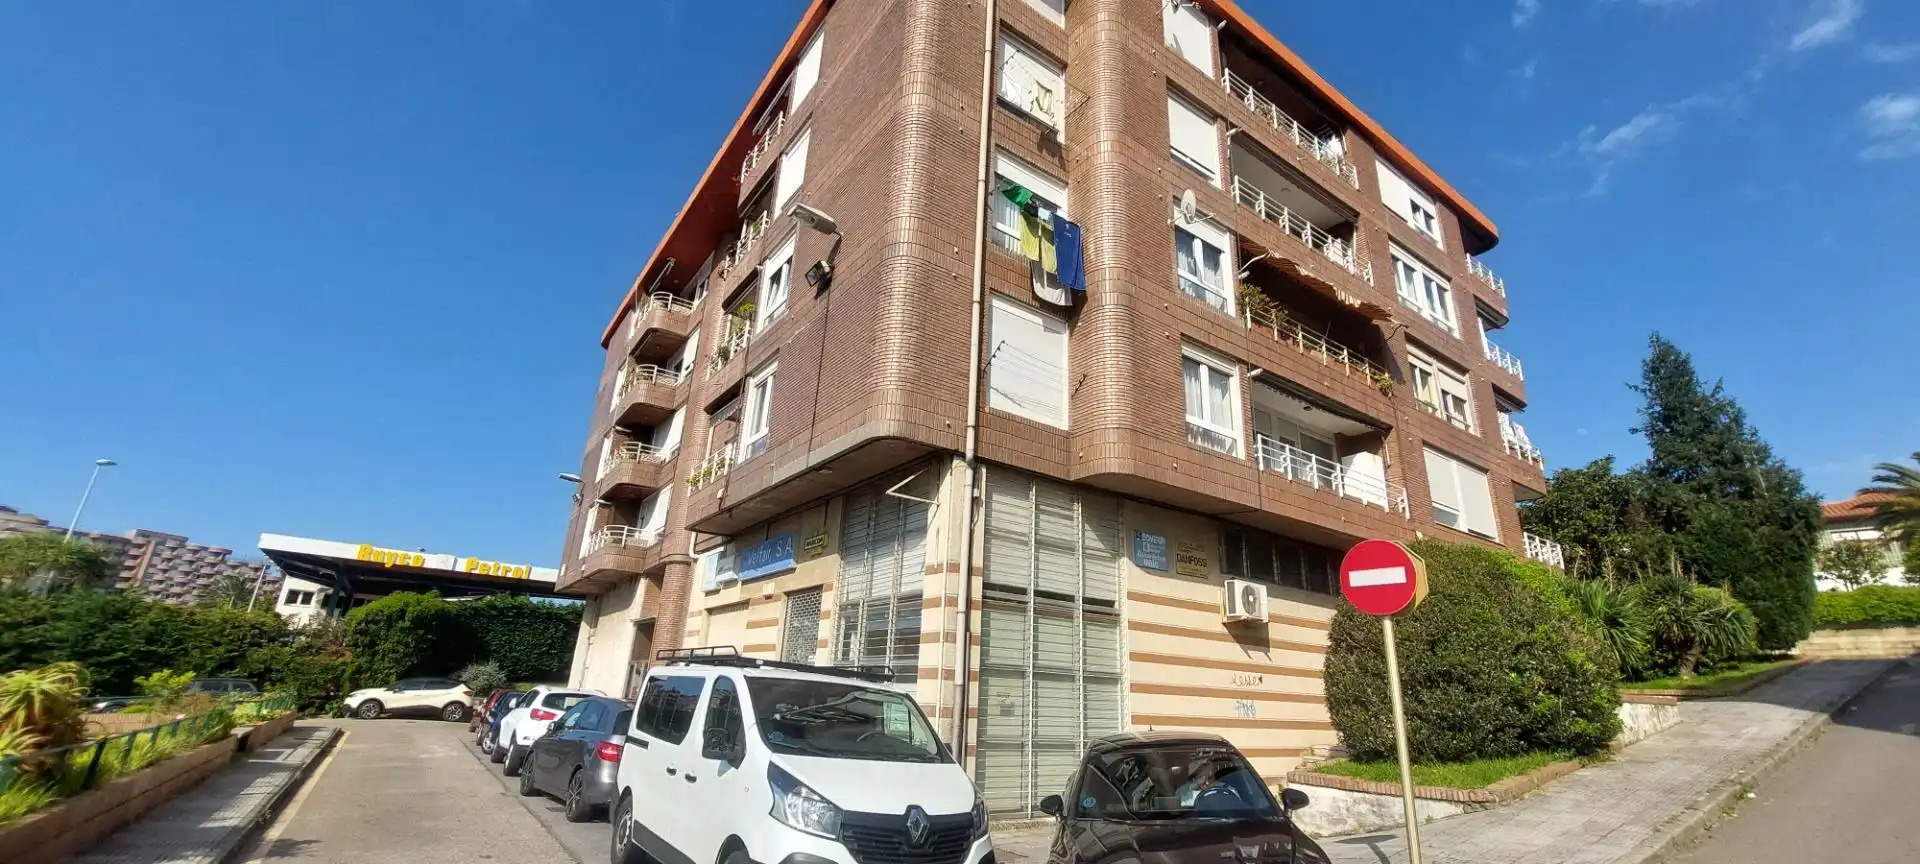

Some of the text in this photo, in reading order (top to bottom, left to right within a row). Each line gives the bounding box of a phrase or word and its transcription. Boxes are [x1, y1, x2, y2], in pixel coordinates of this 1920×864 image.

[356, 543, 532, 580] Ruyco Petrol
[1176, 552, 1208, 568] DANFOSS
